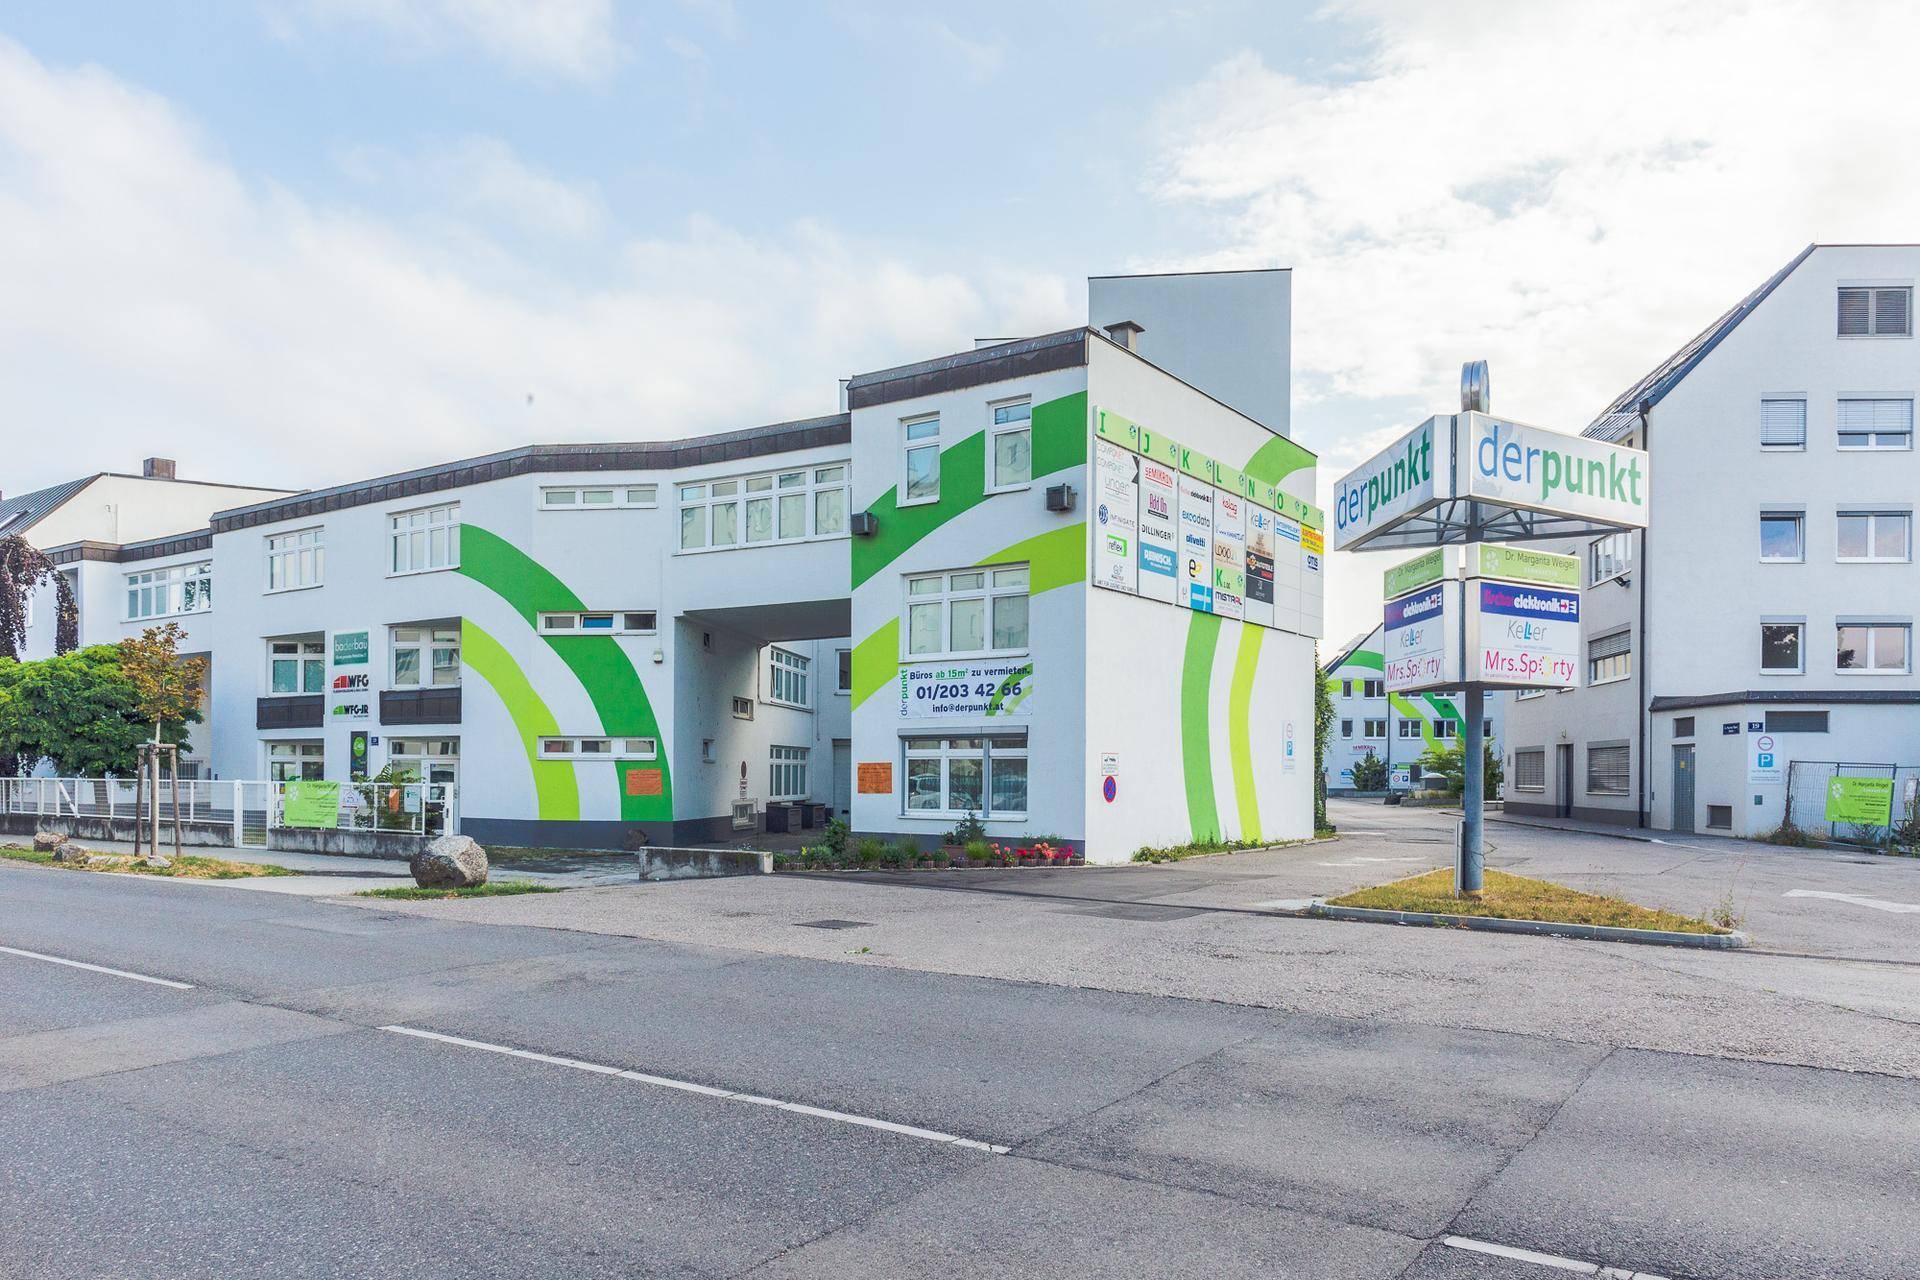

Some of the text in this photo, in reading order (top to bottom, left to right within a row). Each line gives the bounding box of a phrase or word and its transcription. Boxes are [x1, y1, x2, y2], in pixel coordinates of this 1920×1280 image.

[1100, 412, 1105, 433] I
[1143, 433, 1150, 453] J
[1182, 449, 1190, 470] K
[1478, 425, 1642, 506] derpunkt
[1145, 467, 1173, 486] SEMIKRON
[1216, 464, 1222, 483] L
[1337, 429, 1431, 530] derpunkt
[1248, 479, 1255, 498] N
[1303, 505, 1308, 521] P
[1141, 524, 1172, 541] DILLINGER
[1109, 541, 1123, 553] reflex
[1505, 550, 1575, 571] Dr. Margarita Weigel
[1216, 568, 1223, 587] K
[348, 674, 369, 687] WFG
[910, 671, 933, 680] Büros
[935, 670, 945, 679] ab
[900, 669, 909, 716] derpunkt
[916, 682, 1022, 700] 01/203 42 66
[344, 705, 369, 715] WFG-JR
[933, 702, 1004, 713] info@derpunkt.at
[1761, 754, 1771, 767] P
